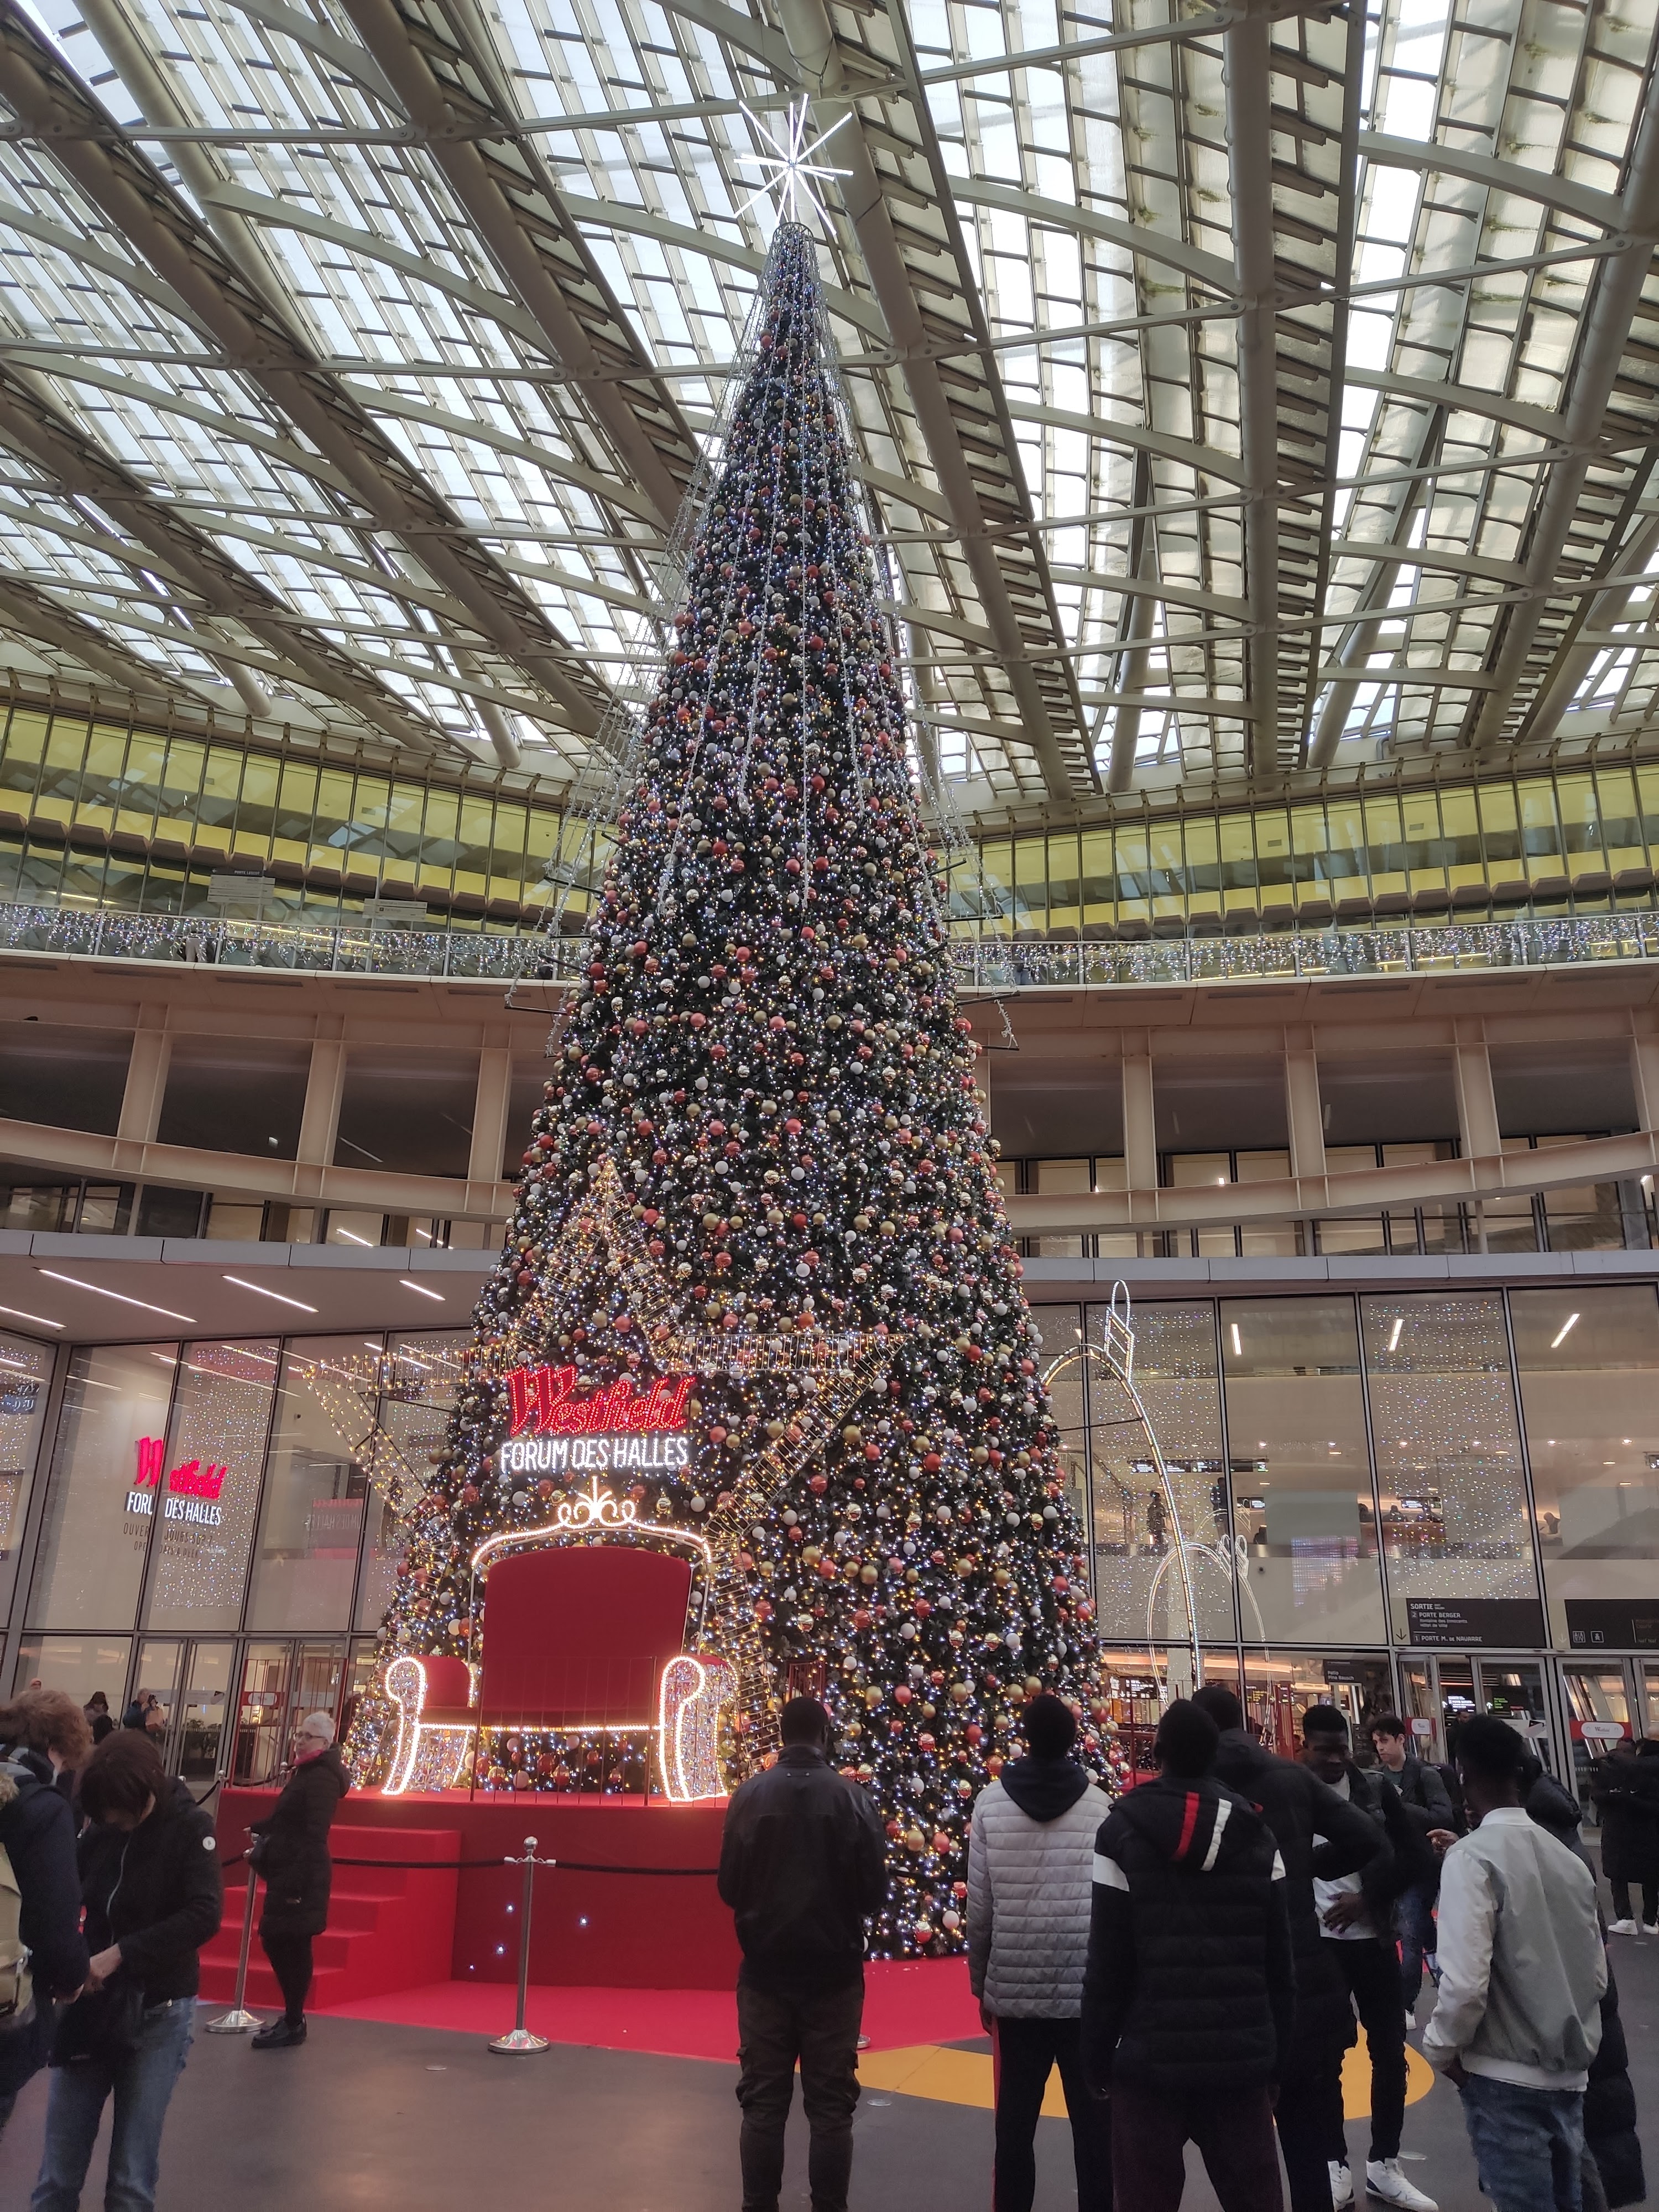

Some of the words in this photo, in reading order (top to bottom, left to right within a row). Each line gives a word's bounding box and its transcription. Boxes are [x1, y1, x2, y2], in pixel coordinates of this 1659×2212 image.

[505, 1365, 695, 1437] Westfield
[134, 1436, 228, 1500] Wstfield
[500, 1437, 569, 1474] FORUM
[572, 1438, 609, 1469] DES
[613, 1437, 689, 1468] HALLES
[165, 1498, 185, 1520] DES
[185, 1501, 222, 1526] HALLES
